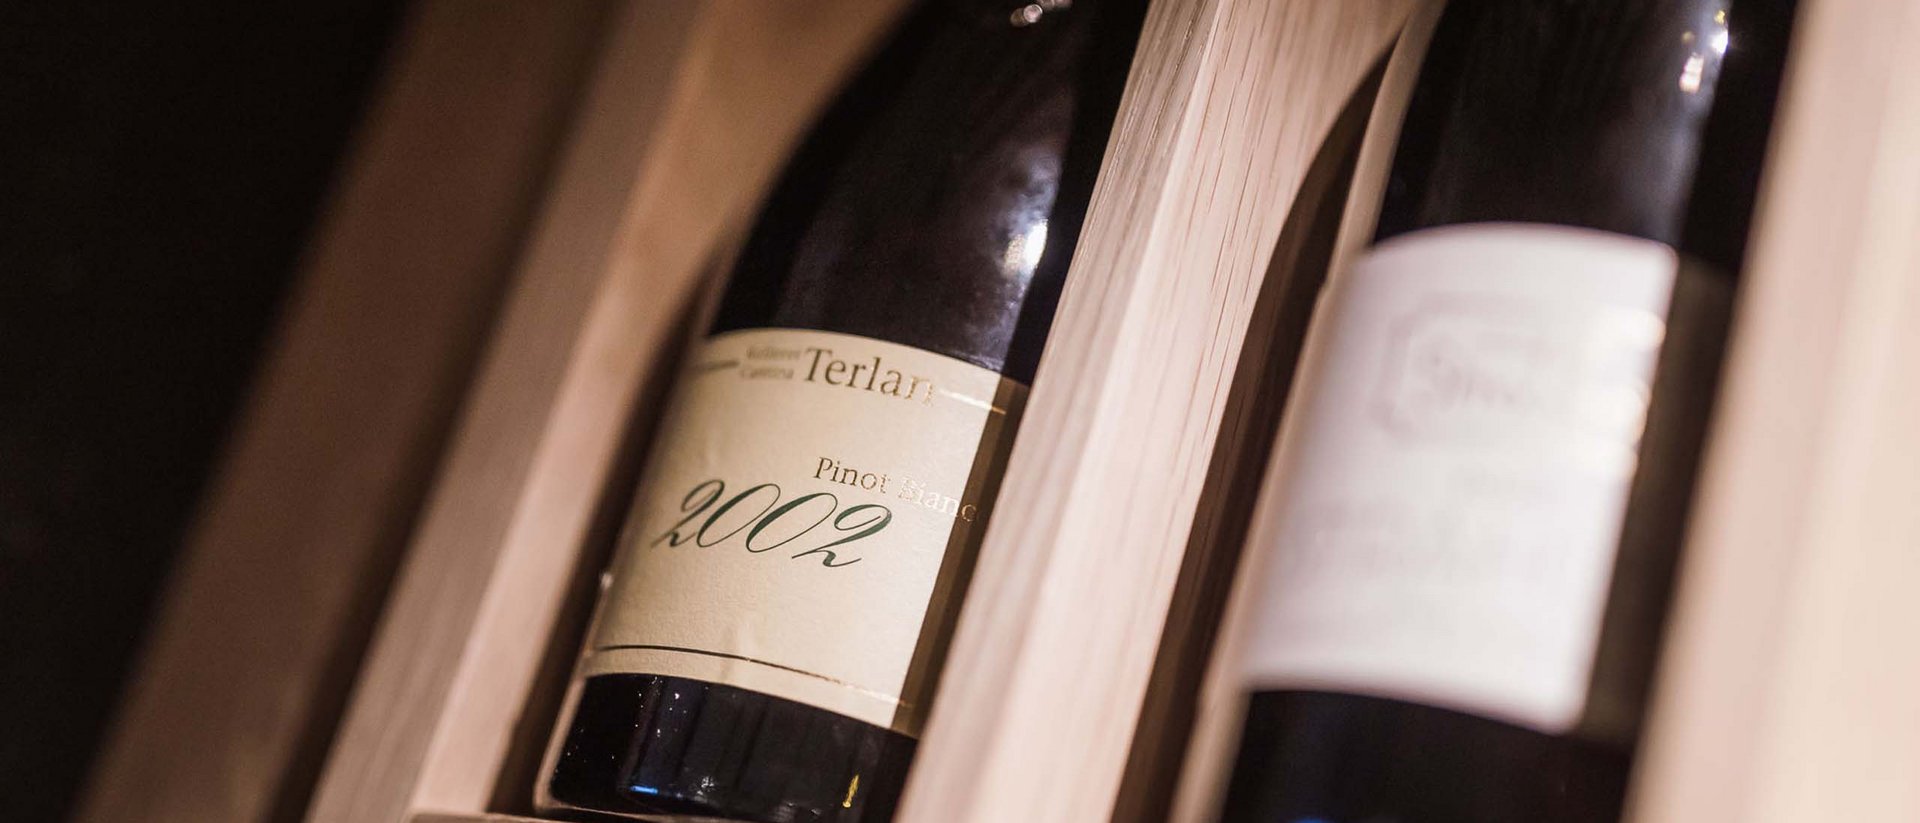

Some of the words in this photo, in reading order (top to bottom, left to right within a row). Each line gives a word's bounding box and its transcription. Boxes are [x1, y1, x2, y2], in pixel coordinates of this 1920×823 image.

[803, 347, 936, 407] Terlan
[813, 457, 892, 495] Pinot
[650, 479, 893, 567] 2002
